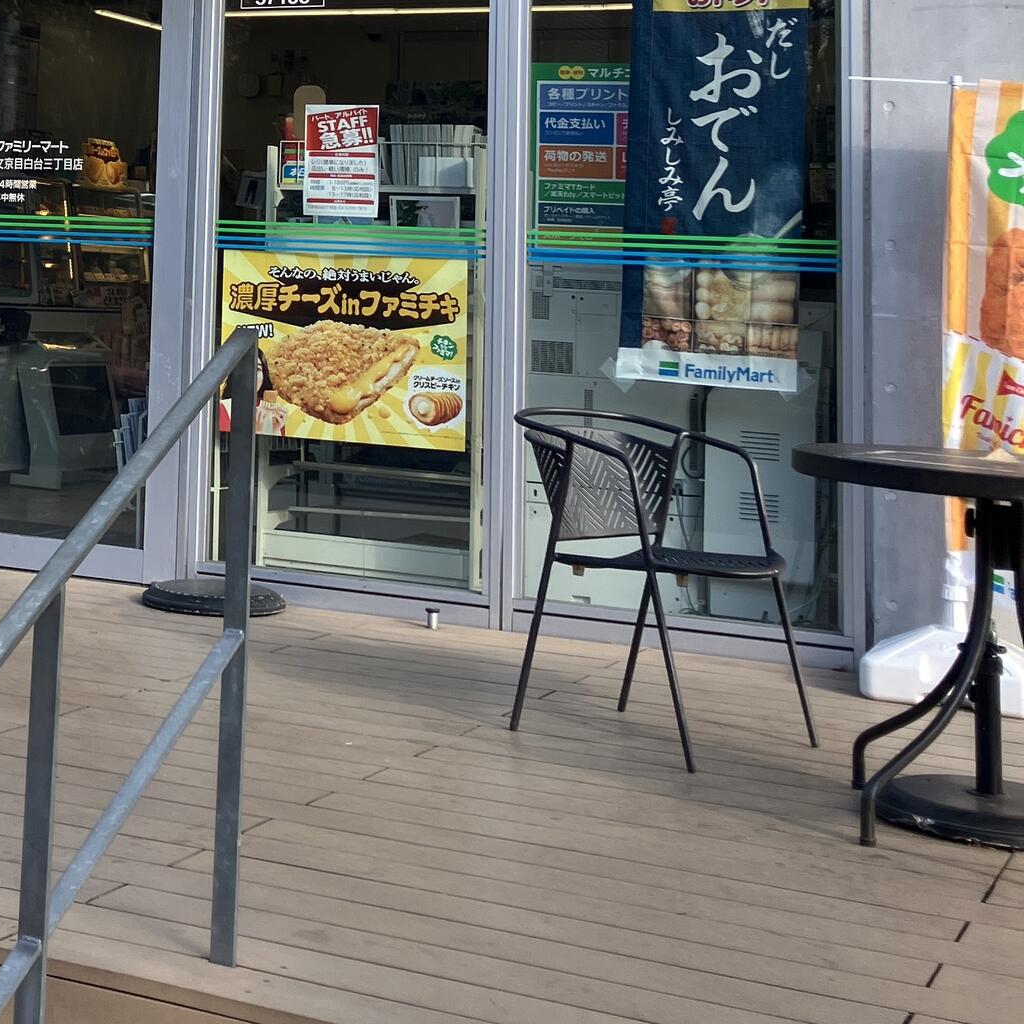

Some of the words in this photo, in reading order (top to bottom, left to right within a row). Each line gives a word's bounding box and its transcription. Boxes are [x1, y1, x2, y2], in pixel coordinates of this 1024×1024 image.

[317, 116, 368, 133] STAFF
[544, 117, 606, 130] 代金支払い
[689, 32, 763, 222] おでん
[544, 150, 608, 163] 荷物の発送
[658, 107, 684, 212] しみしみ亭
[269, 266, 421, 285] そんなの、絶対うまいじゃん。
[229, 281, 461, 322] 濃厚チーズinファミチキ
[684, 363, 775, 383] FamilyMart
